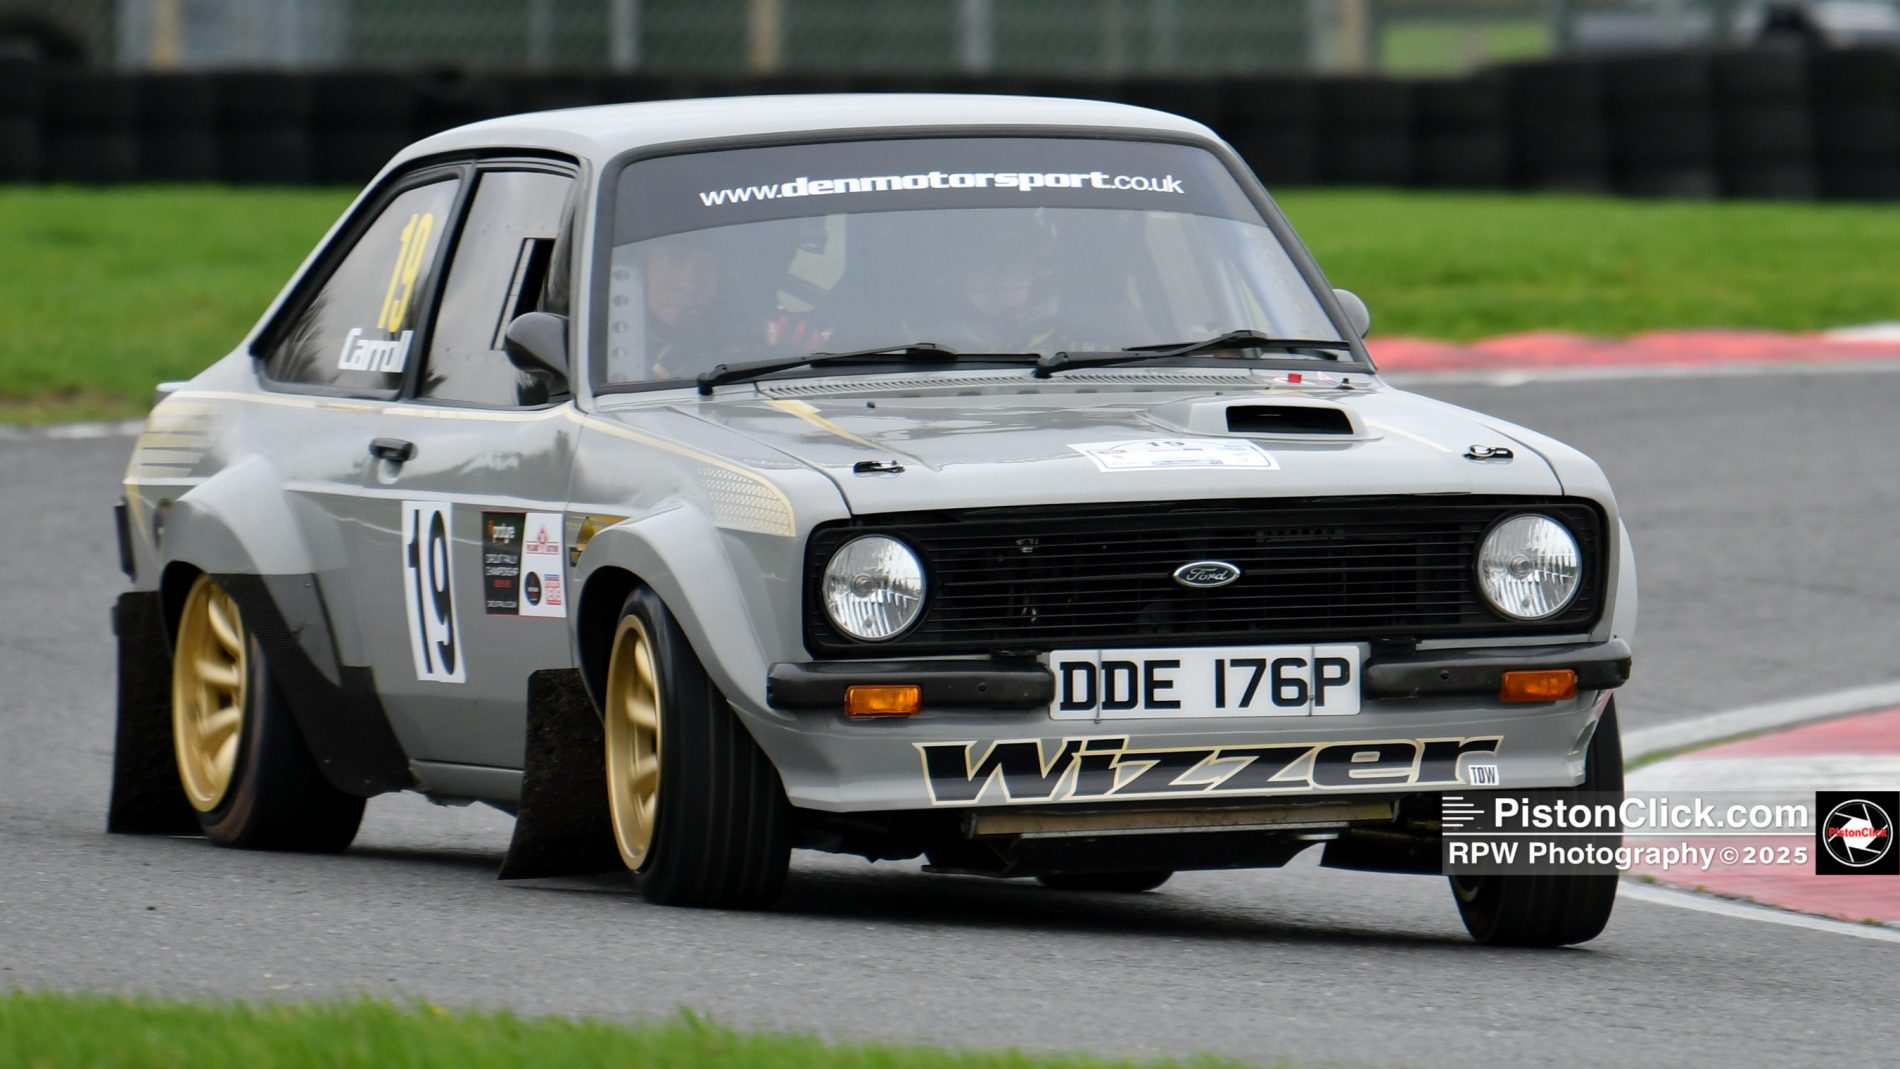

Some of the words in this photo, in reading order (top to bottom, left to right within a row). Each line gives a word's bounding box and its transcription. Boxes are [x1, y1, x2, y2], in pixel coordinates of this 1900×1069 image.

[699, 171, 1185, 207] www.denmotorsport.co.uk
[376, 213, 433, 332] 19
[408, 510, 455, 675] 19
[1186, 567, 1228, 580] Ford
[1059, 660, 1181, 711] DDE
[1214, 657, 1351, 708] 176P
[912, 735, 1504, 805] Wizzer
[1470, 766, 1496, 784] TOW
